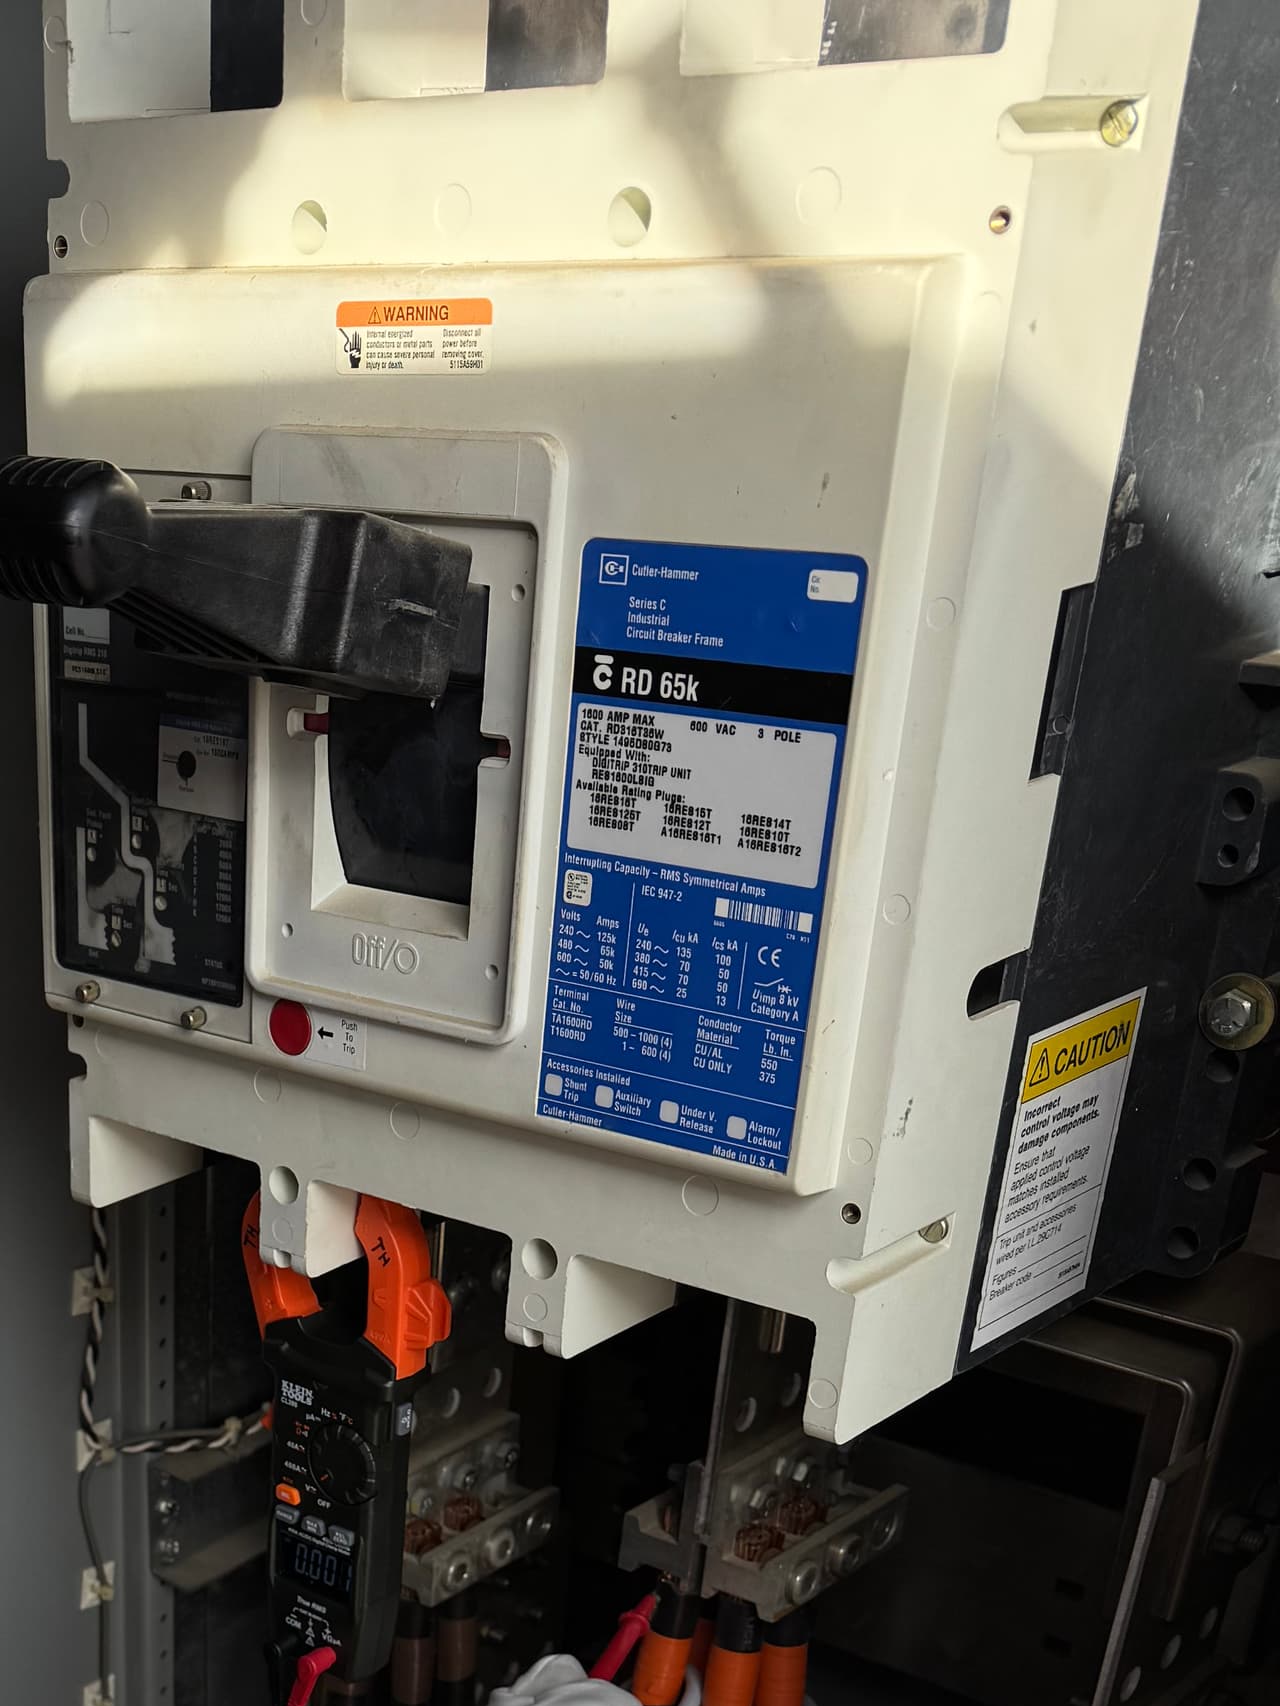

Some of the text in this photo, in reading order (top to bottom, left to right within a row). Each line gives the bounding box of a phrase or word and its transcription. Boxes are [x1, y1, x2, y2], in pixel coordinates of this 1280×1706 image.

[384, 305, 449, 321] WARNING
[631, 564, 699, 582] Cutler-Hammer
[629, 596, 667, 611] Series C
[628, 611, 670, 627] Industrial
[626, 627, 724, 648] Circuit Breaker Frame
[621, 665, 701, 703] RD 65k
[580, 720, 602, 732] CAT.
[582, 708, 801, 743] 1600 AMP MAX 600 VAC 3 POLE
[579, 732, 610, 746] STYLE
[578, 744, 651, 762] Equipped With:
[670, 767, 692, 780] UNIT
[576, 779, 618, 795] Available
[621, 785, 652, 801] Rating
[564, 852, 766, 898] Interrupting Capacity RMS Symmetrical Amps
[641, 884, 682, 902] IEC 947-2
[560, 908, 582, 922] Volts
[596, 915, 620, 930] Amps
[559, 924, 617, 945] 240 125k
[687, 931, 738, 952] kA kA
[557, 938, 615, 958] 480 65k
[635, 938, 732, 967] 240 135 100
[556, 951, 614, 971] 600 50k
[634, 951, 730, 980] 380 70 50
[579, 968, 617, 986] 50/60 Hz
[632, 965, 728, 993] 415 70 50
[553, 984, 590, 1002] Terminal
[631, 978, 727, 1007] 690 25 13
[778, 995, 800, 1008] 8 kV
[570, 1002, 584, 1013] No.
[616, 997, 636, 1011] Wire
[750, 1002, 799, 1022] Category A
[341, 1019, 358, 1032] Push
[551, 1012, 593, 1030] TA1600RD
[614, 1011, 633, 1024] Size
[697, 1014, 742, 1034] Conductor
[344, 1032, 354, 1043] To
[550, 1024, 586, 1042] T1600RD
[613, 1025, 673, 1050] 500 1000 (4)
[696, 1027, 733, 1046] Material
[765, 1028, 796, 1046] Torque
[342, 1043, 356, 1055] Trip
[621, 1041, 672, 1063] 1 600 (4)
[694, 1042, 723, 1060] CU/AL
[762, 1042, 777, 1055] Lb.
[1053, 1020, 1131, 1076] CAUTION
[546, 1057, 631, 1086] Accessories Installed
[692, 1056, 733, 1075] CU ONLY
[760, 1057, 778, 1071] 550
[564, 1077, 587, 1092] Shunt
[759, 1071, 776, 1085] 375
[563, 1089, 580, 1104] Trip
[615, 1088, 652, 1108] Auxiliary
[542, 1103, 603, 1127] Cutler-Hammer
[614, 1100, 642, 1117] Switch
[681, 1104, 718, 1122] Under V.
[1020, 1094, 1099, 1138] control voltage may
[1023, 1096, 1061, 1122] Incorrect
[679, 1116, 714, 1134] Release
[748, 1120, 782, 1138] Alarm/
[1017, 1107, 1100, 1154] damage components.
[747, 1133, 782, 1151] Lockout
[712, 1144, 778, 1171] Made in U.S.A.
[1013, 1146, 1056, 1175] Ensure that
[1039, 1156, 1064, 1178] control
[1039, 1166, 1070, 1191] installed
[370, 1236, 391, 1268] TH
[281, 1379, 314, 1399] KLEIN
[282, 1388, 313, 1407] TOOLS
